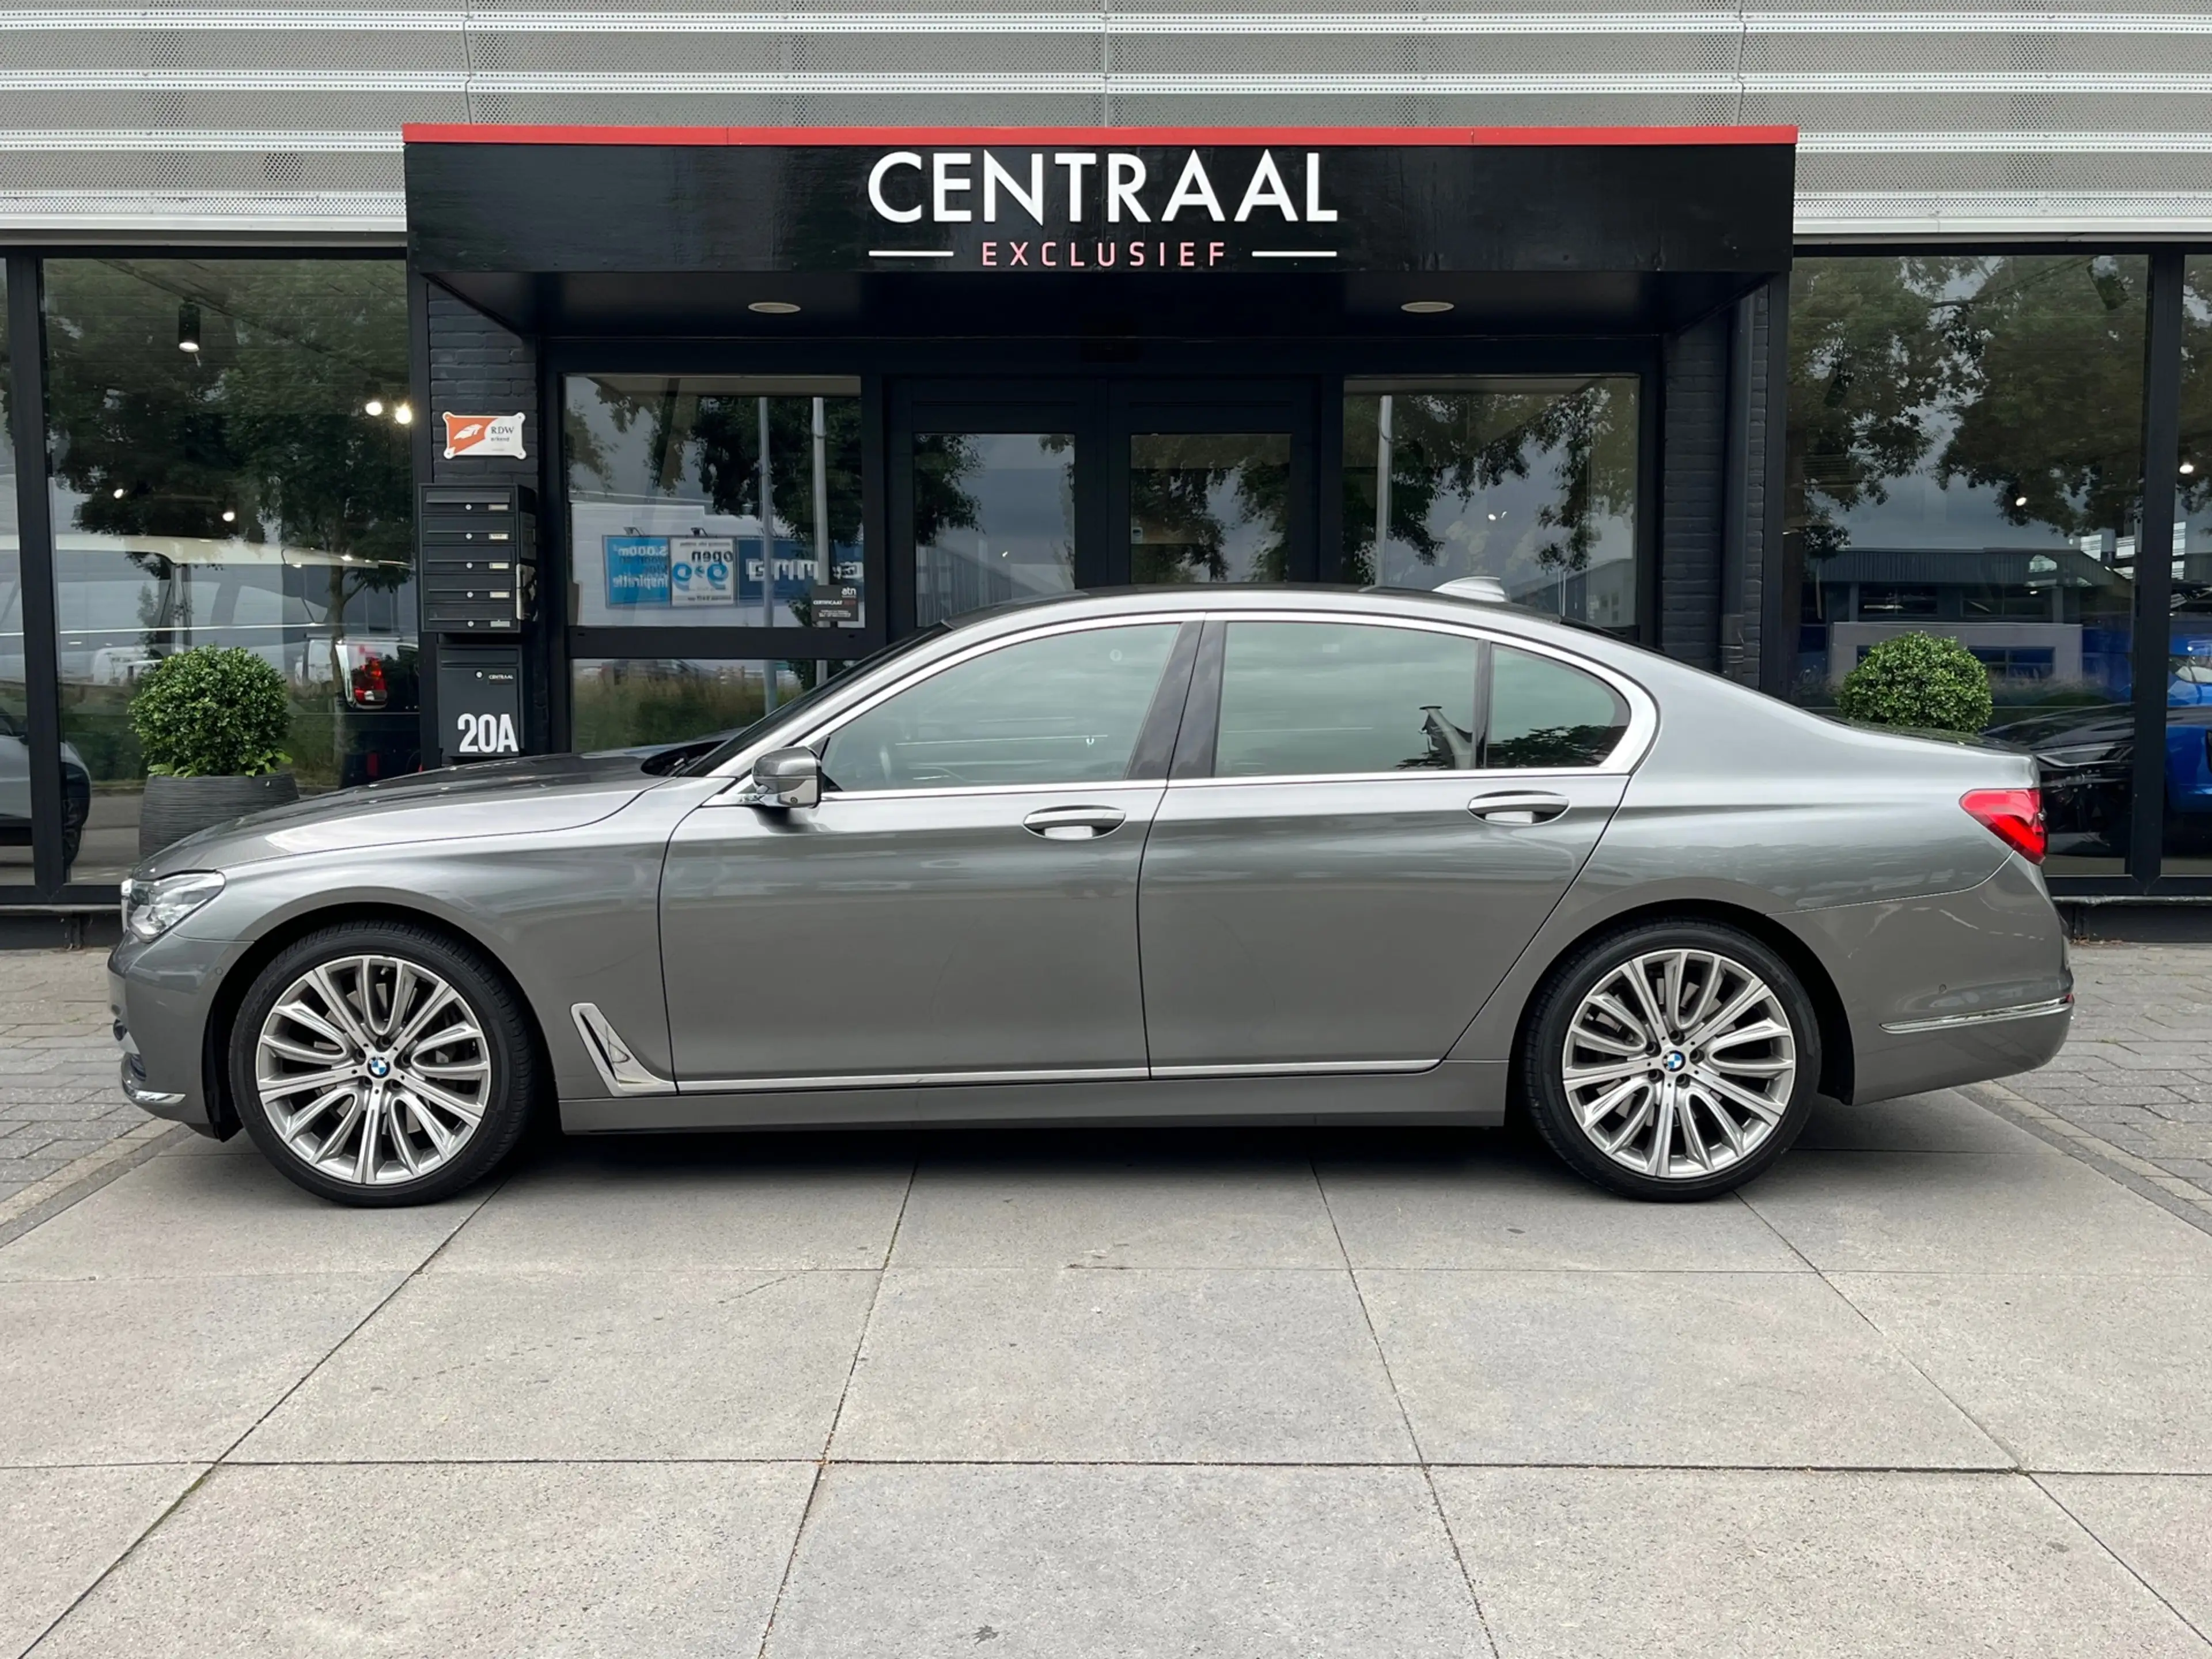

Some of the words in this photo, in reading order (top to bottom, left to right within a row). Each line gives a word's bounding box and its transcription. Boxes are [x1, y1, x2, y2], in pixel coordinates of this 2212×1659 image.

[868, 149, 1338, 228] CENTRAAL
[982, 241, 1225, 266] EXCLUSIEF
[457, 713, 518, 753] 20A
